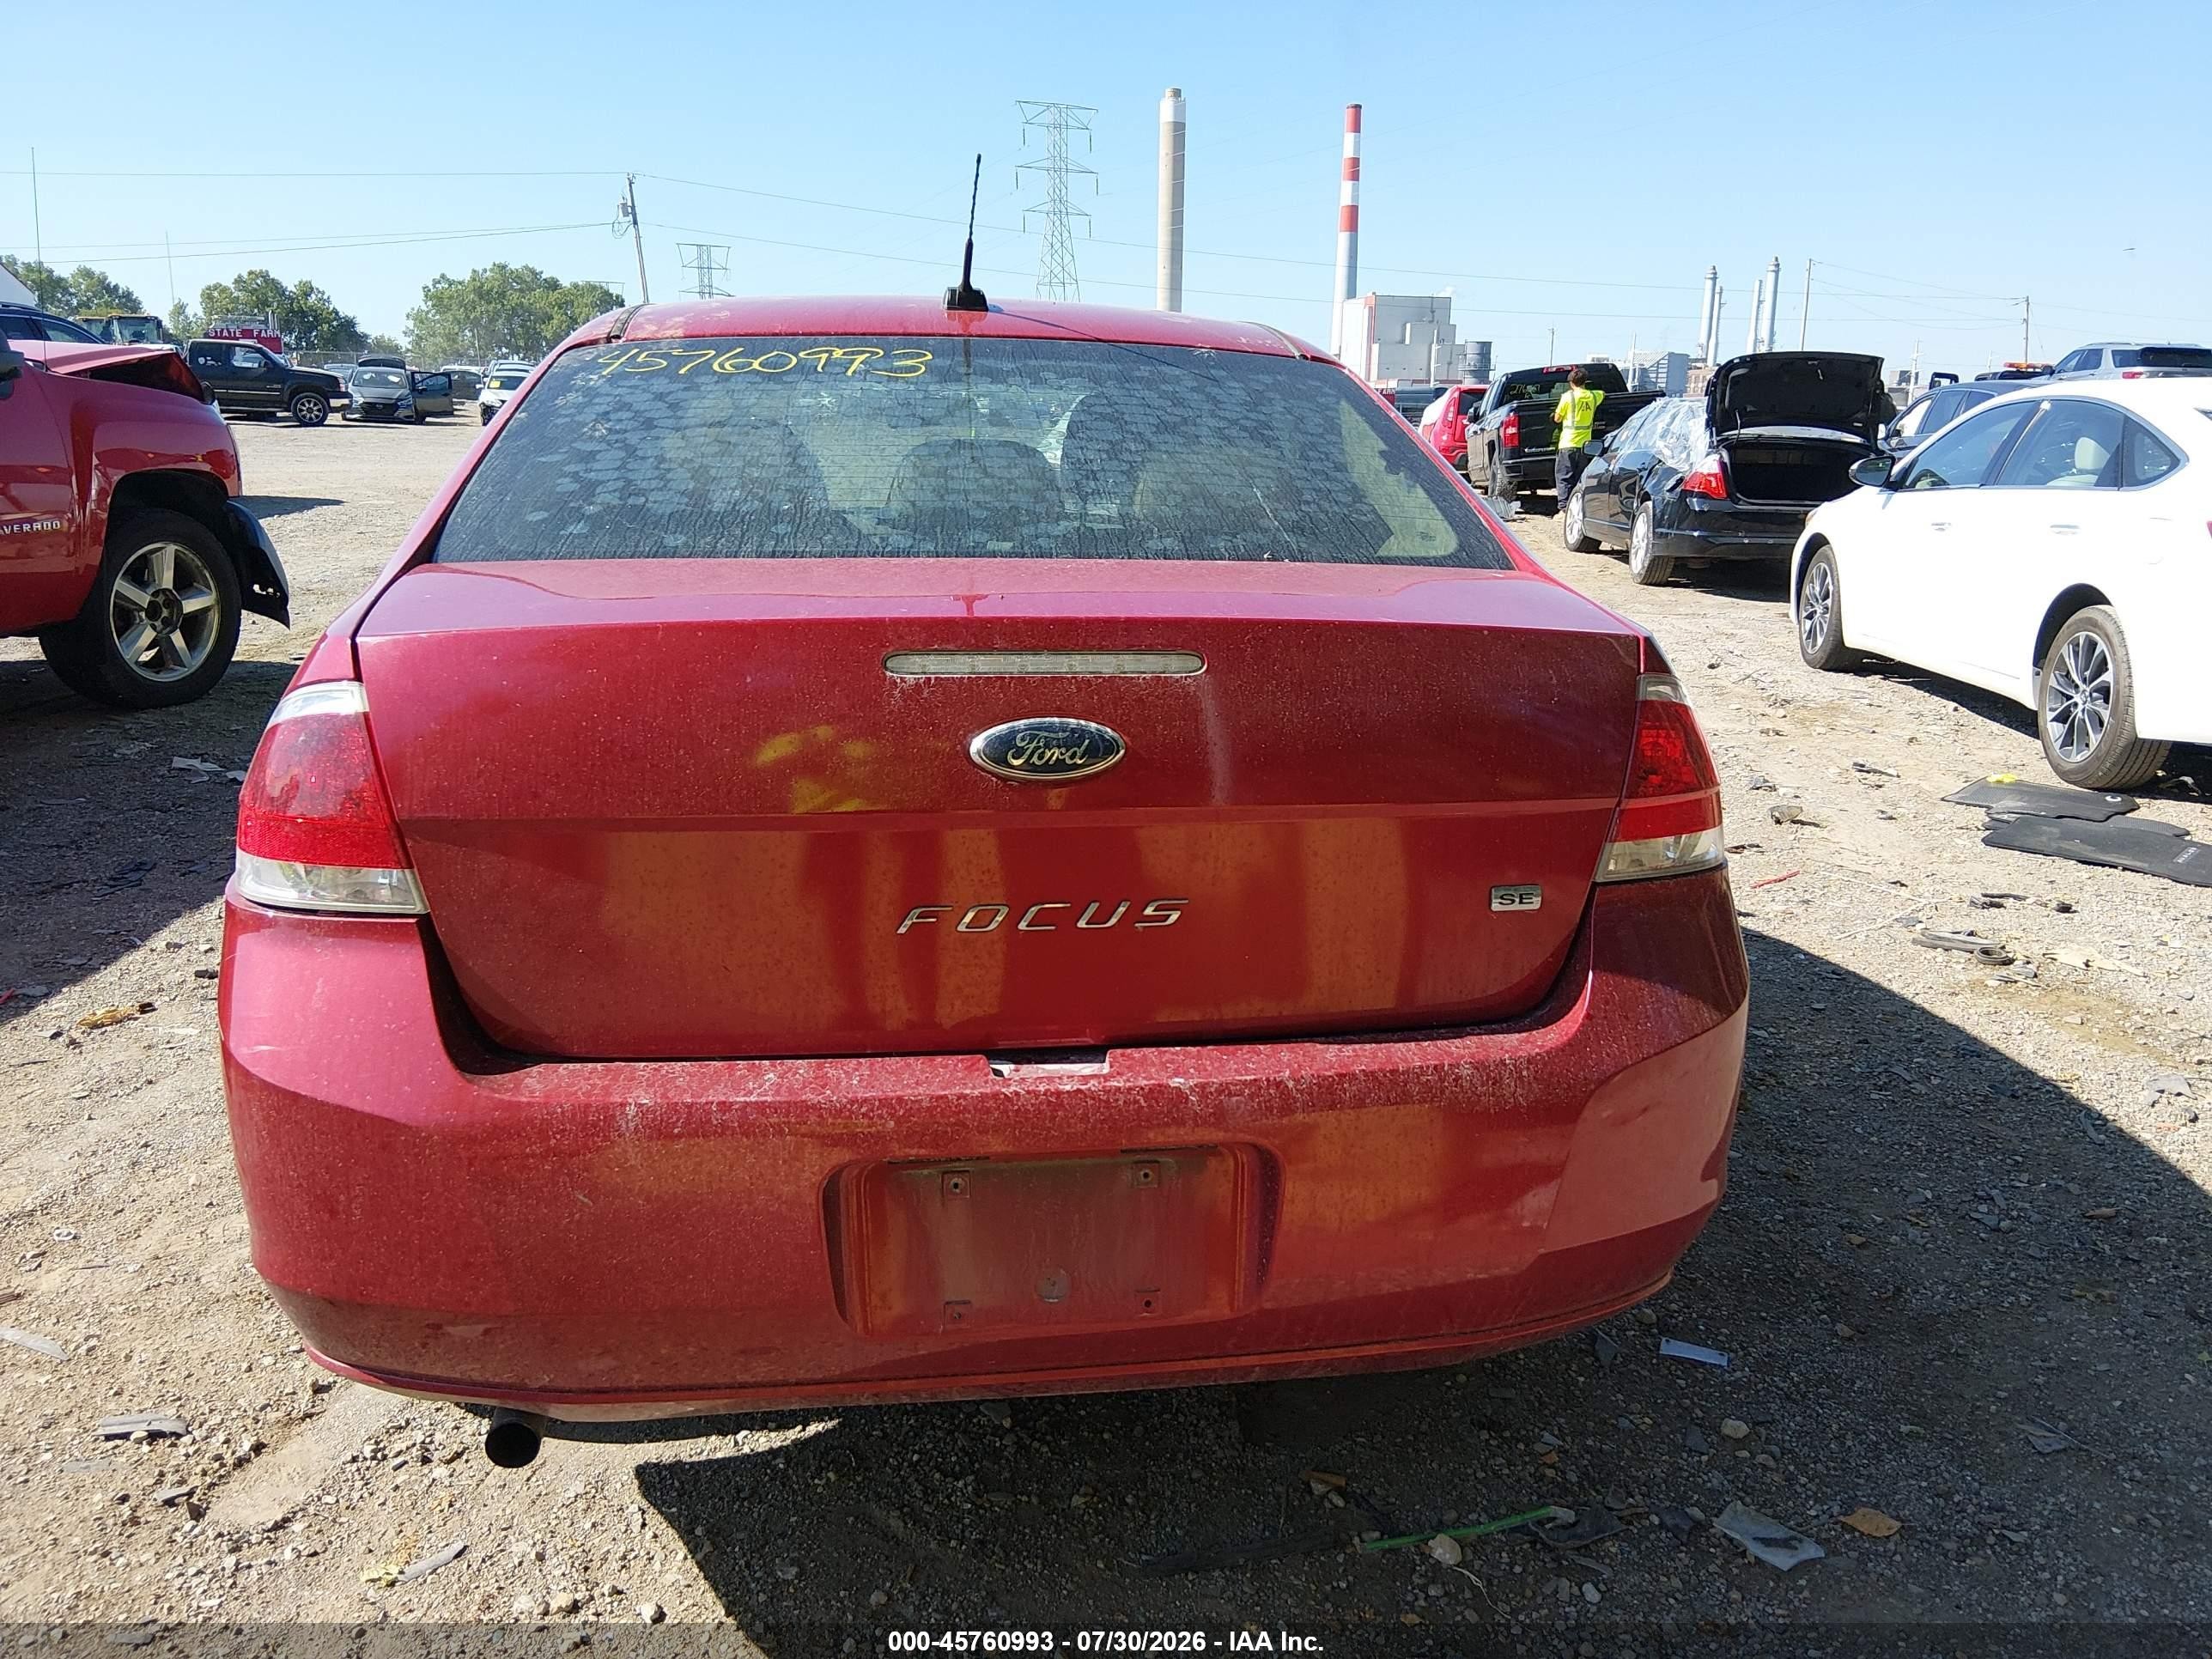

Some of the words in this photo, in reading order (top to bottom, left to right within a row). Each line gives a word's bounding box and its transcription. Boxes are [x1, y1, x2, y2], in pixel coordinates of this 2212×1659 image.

[208, 329, 243, 337] STATE
[252, 329, 281, 337] FARM
[598, 347, 933, 377] 45760993
[1006, 730, 1091, 767] Ford
[1498, 892, 1534, 906] SE
[896, 899, 1189, 934] FOCUS
